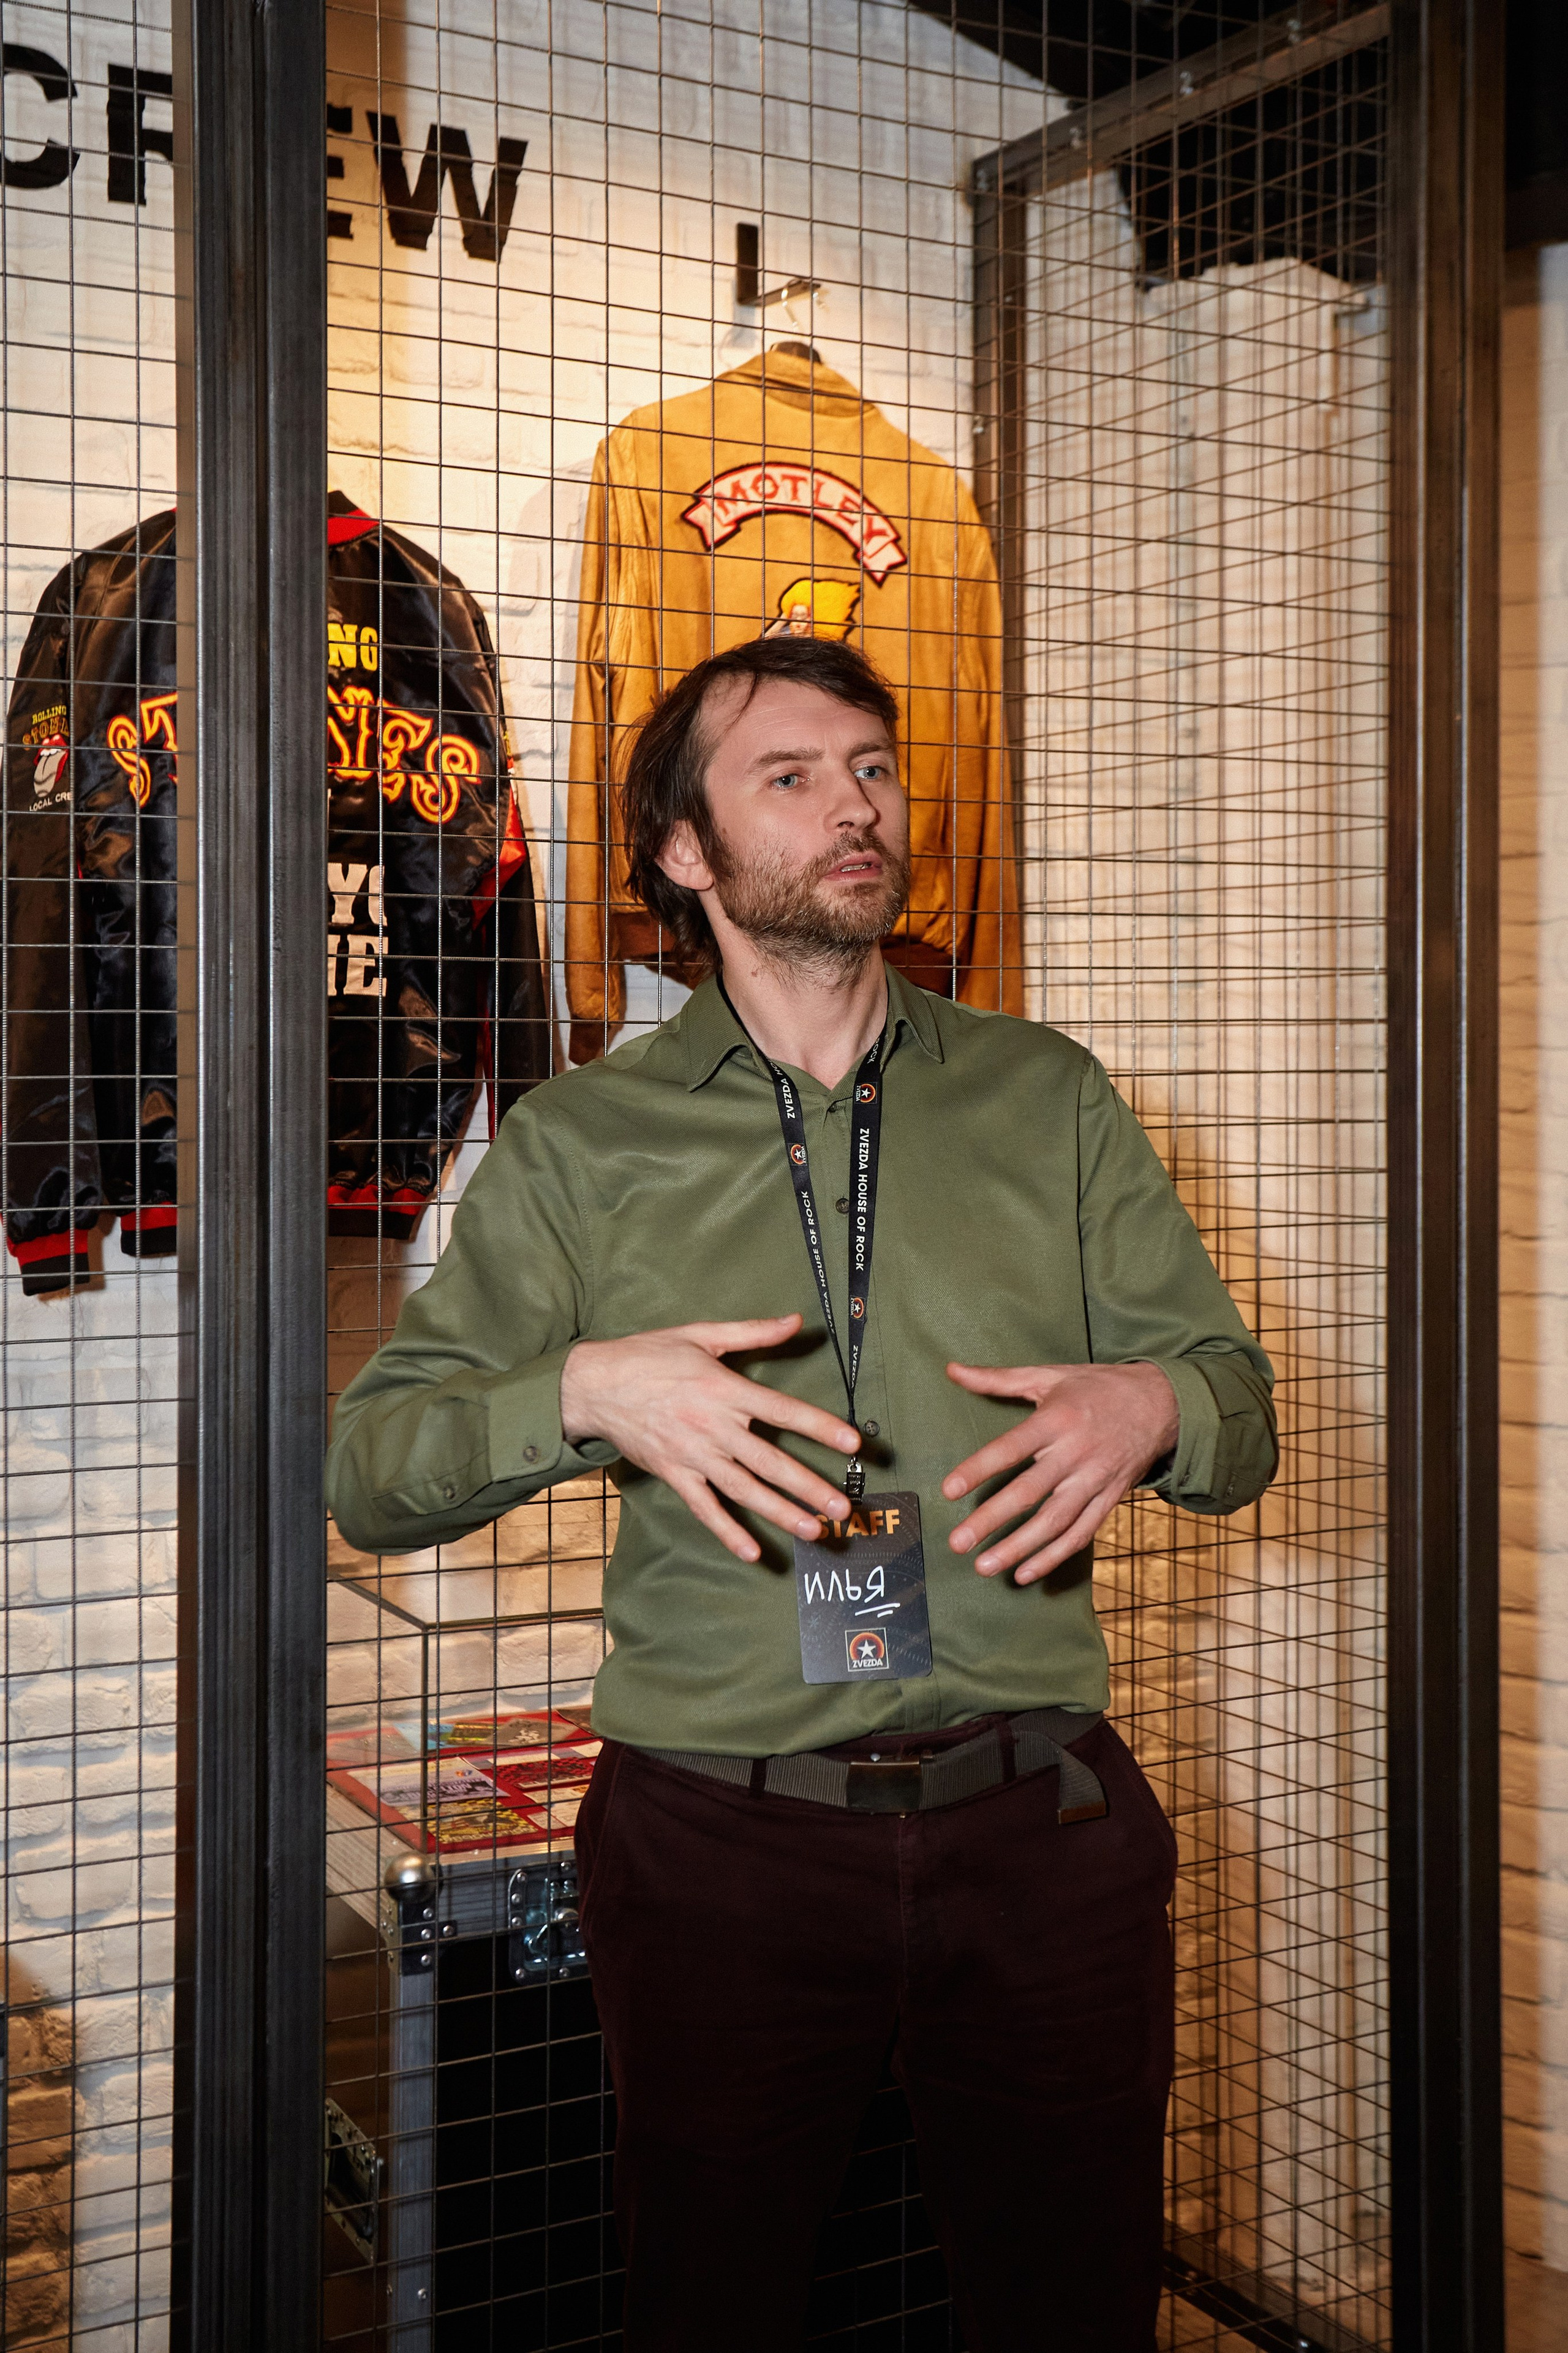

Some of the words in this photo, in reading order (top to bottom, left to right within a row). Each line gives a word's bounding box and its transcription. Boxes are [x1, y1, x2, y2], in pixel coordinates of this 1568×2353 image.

[32, 704, 67, 725] ROLLING
[29, 797, 53, 812] LOCAL
[55, 791, 74, 803] CRE
[780, 1078, 796, 1119] ZVEZDA
[859, 1128, 869, 1170] ZVEZDA
[801, 1191, 815, 1226] ROCK
[858, 1174, 868, 1213] HOUSE
[810, 1229, 817, 1245] OF
[857, 1216, 866, 1233] OF
[813, 1248, 826, 1287] HOUSE
[856, 1235, 865, 1271] ROCK
[852, 1658, 883, 1668] ZVEZDA
